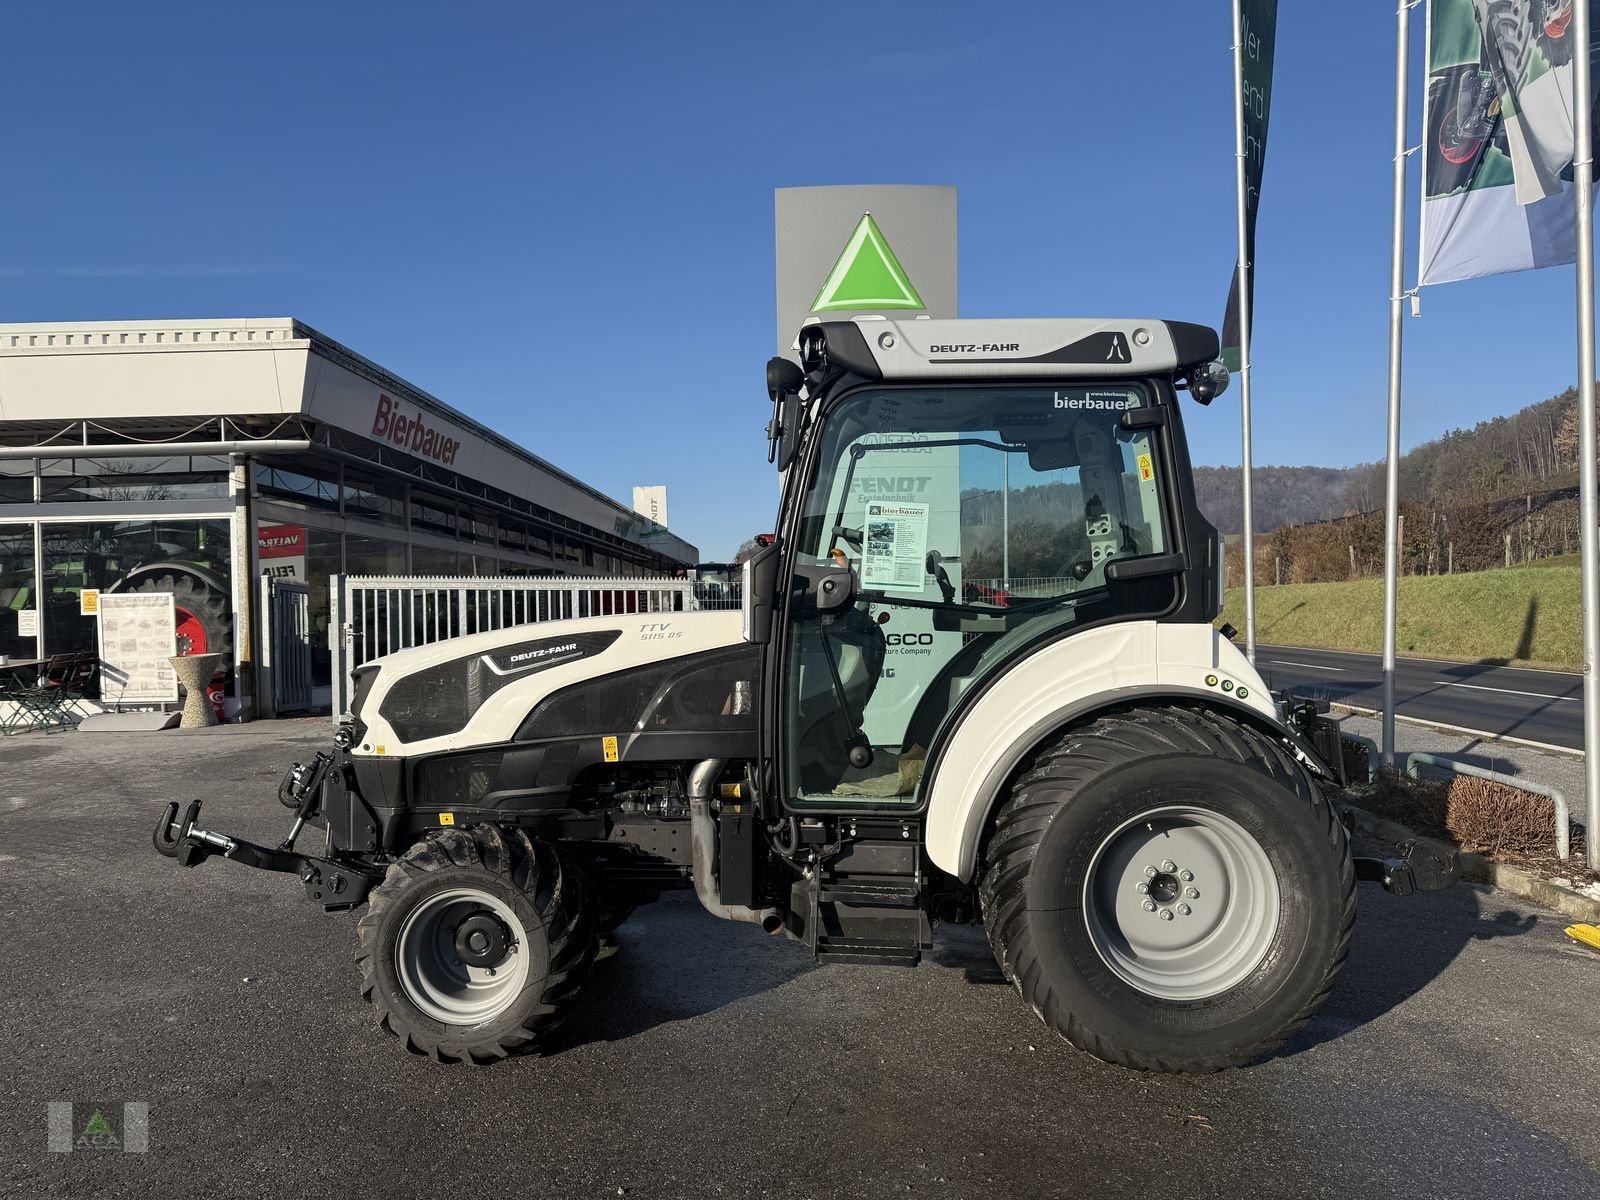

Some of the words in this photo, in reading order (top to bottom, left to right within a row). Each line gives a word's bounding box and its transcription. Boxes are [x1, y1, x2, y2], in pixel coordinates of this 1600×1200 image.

[930, 343, 1020, 353] DEUTZ-FAHR
[1054, 391, 1131, 410] bierbauer
[372, 393, 461, 465] Bierbauer
[849, 476, 932, 493] FENDT
[640, 622, 671, 632] TTV
[885, 633, 934, 646] GCO
[510, 643, 577, 662] DEUTZ-FAHR
[900, 647, 932, 656] Company
